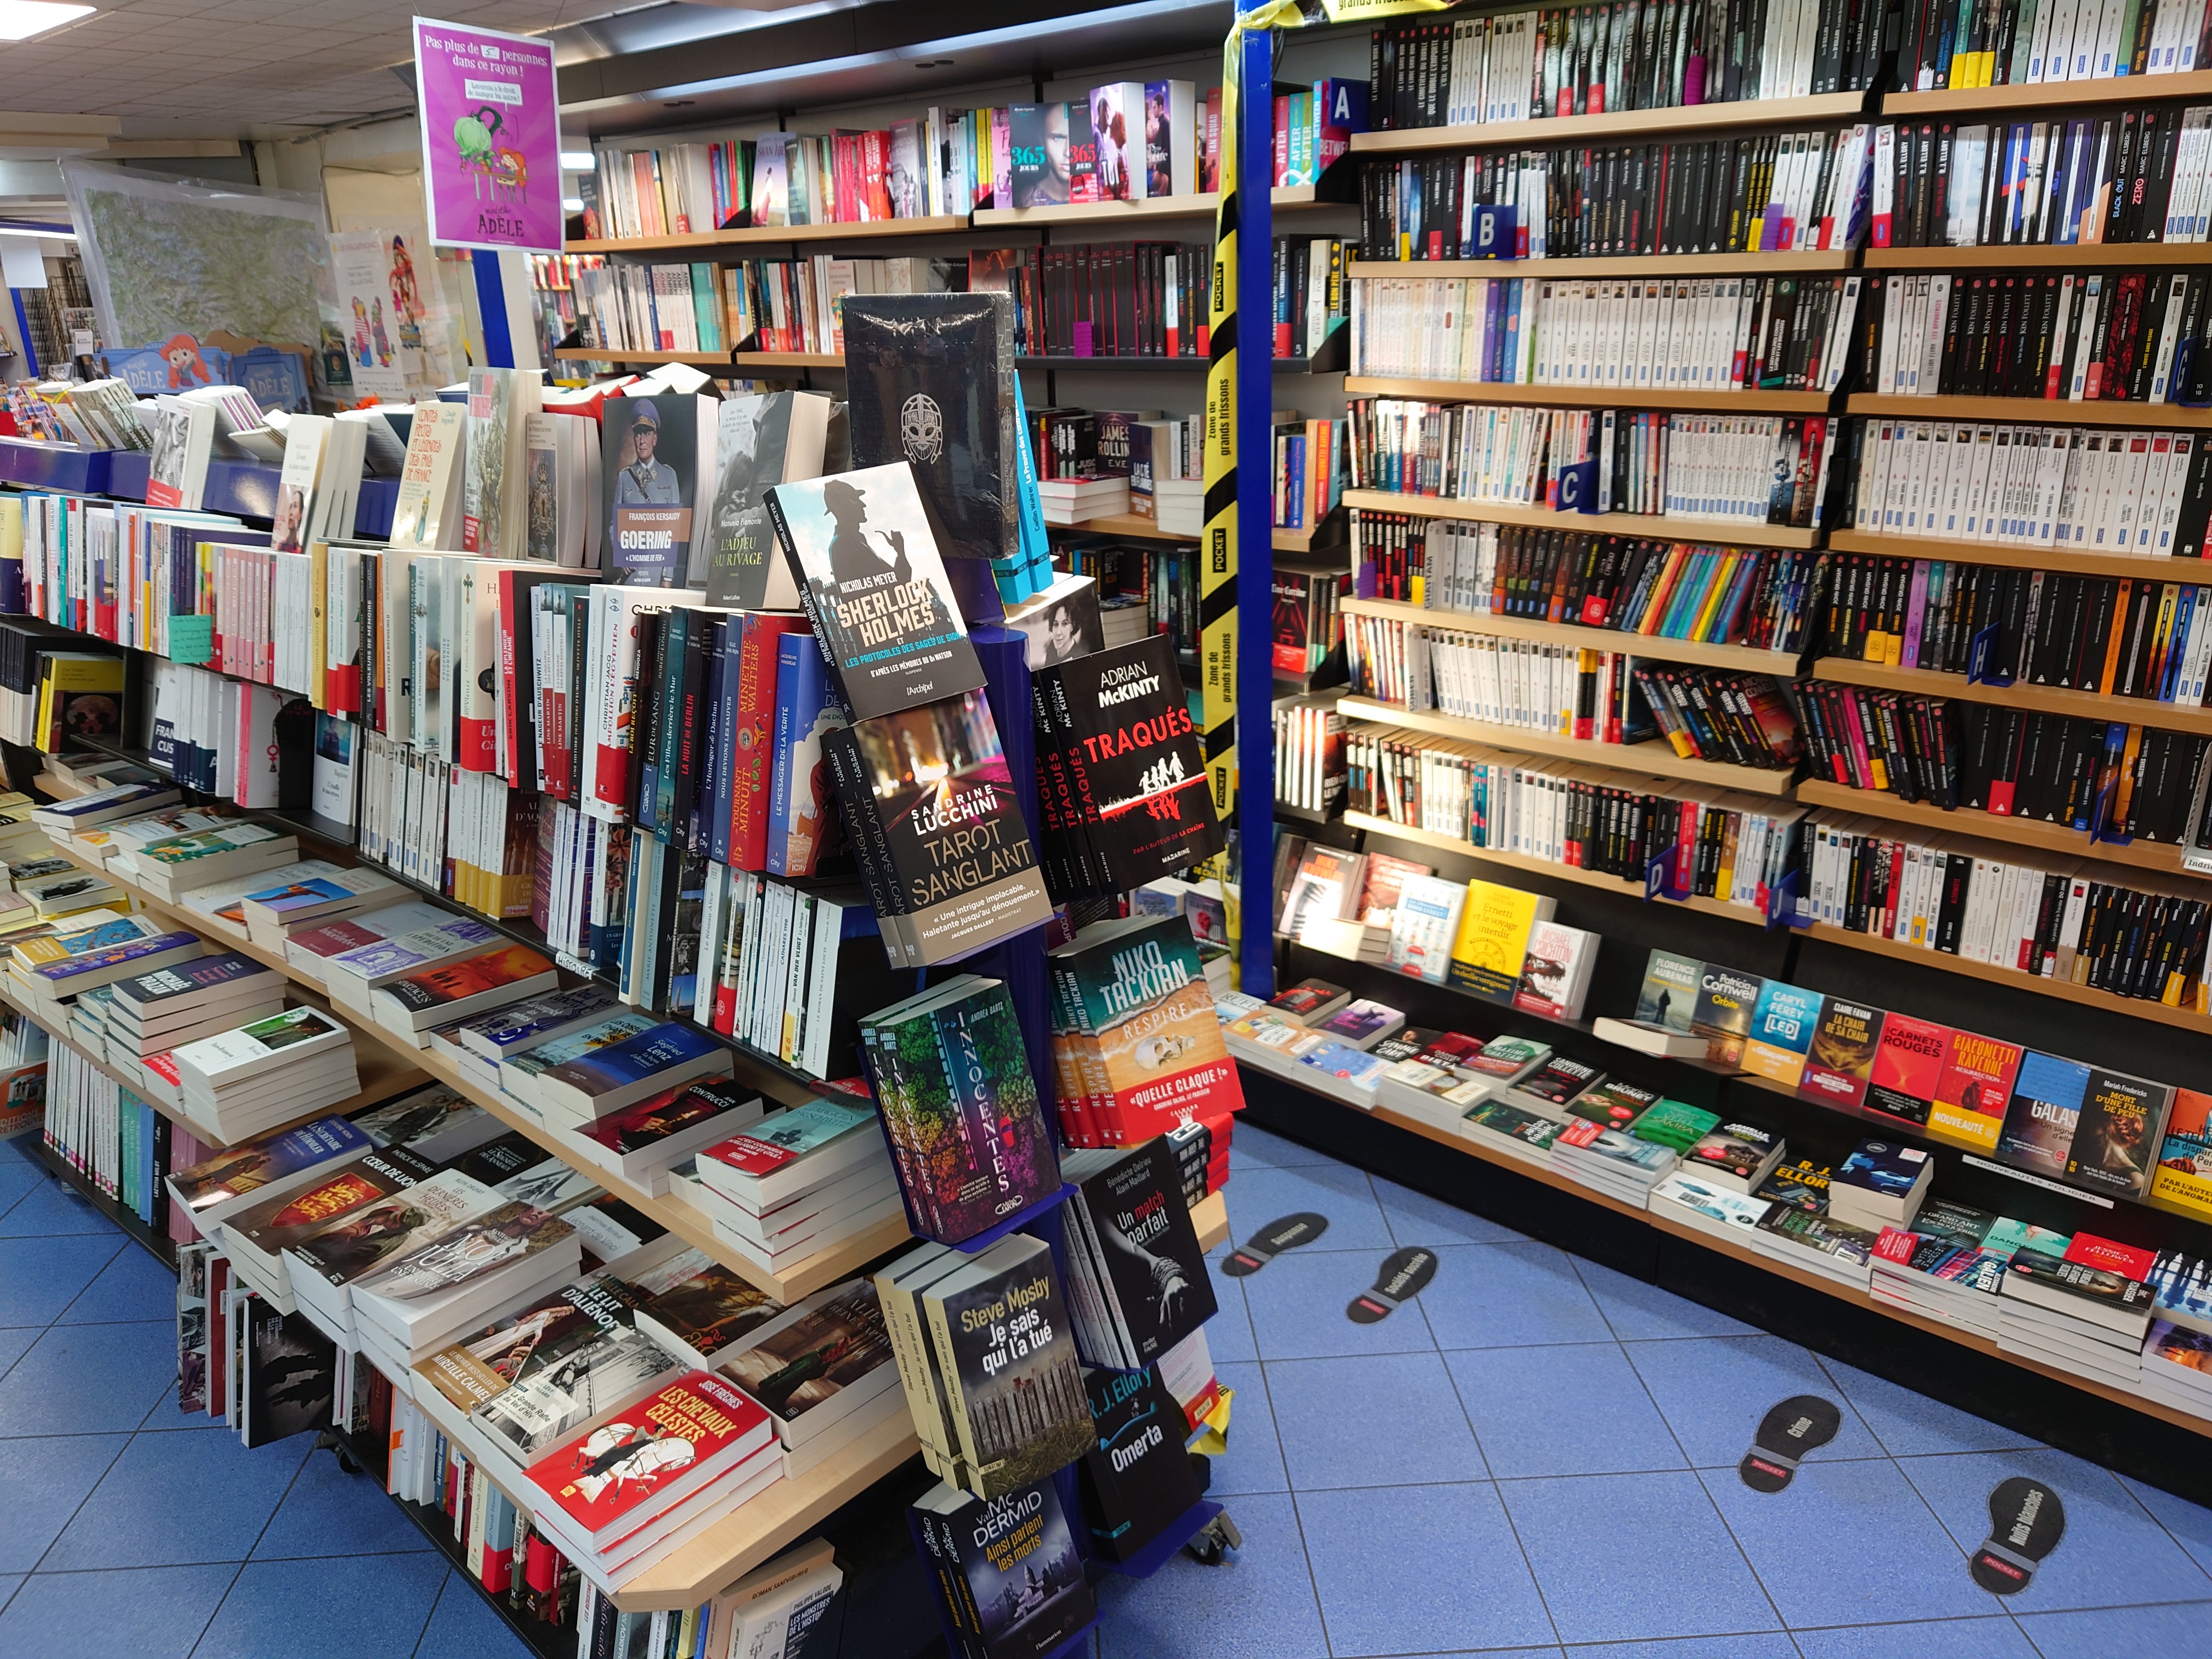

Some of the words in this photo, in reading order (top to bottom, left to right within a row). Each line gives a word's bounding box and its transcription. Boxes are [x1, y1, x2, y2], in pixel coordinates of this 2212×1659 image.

[425, 35, 442, 49] Pas
[445, 39, 465, 53] plus
[467, 42, 478, 54] de
[503, 50, 547, 67] personnes
[453, 54, 475, 70] dans
[477, 61, 488, 71] ce
[490, 63, 518, 76] rayon
[1334, 86, 1350, 119] A
[1012, 146, 1046, 164] 365
[1276, 131, 1286, 162] AFTER
[2123, 131, 2131, 154] ELSBERG
[2132, 178, 2145, 205] ZERO
[2113, 195, 2122, 218] BLACK
[477, 213, 524, 237] ADÈLE
[1480, 213, 1494, 246] B
[1952, 293, 1961, 318] FOLLETT
[1209, 402, 1215, 412] de
[1220, 379, 1228, 423] frissons
[1221, 425, 1230, 456] grands
[1562, 472, 1579, 503] C
[629, 512, 655, 522] FRANÇOIS
[721, 518, 738, 527] Manuela
[741, 517, 761, 526] Piemonte
[620, 530, 672, 549] GOERING
[721, 537, 757, 551] L'ADIEU
[1215, 532, 1224, 569] POCKET
[713, 555, 725, 567] AU
[727, 552, 761, 566] RIVAGE
[839, 579, 872, 594] NICHOLAS
[874, 572, 897, 586] MEYER
[836, 577, 933, 628] SHERLOCK
[859, 603, 935, 647] HOLMES
[845, 657, 859, 668] LES
[860, 646, 901, 665] PROTOCOLES
[902, 642, 914, 652] DES
[916, 636, 936, 650] SAGES
[938, 635, 945, 645] DE
[946, 632, 961, 644] SION
[740, 640, 751, 713] MINETTE
[747, 645, 758, 712] WALTERS
[906, 681, 933, 695] l'Archipel
[1101, 661, 1148, 689] ADRIAN
[1098, 675, 1160, 708] McKINTY
[781, 736, 786, 745] LA
[1083, 706, 1192, 763] TRAQUÉS
[780, 746, 786, 758] DE
[776, 806, 781, 816] LE
[911, 784, 993, 820] SANDRINE
[913, 794, 998, 836] LUCCHINI
[923, 819, 1001, 867] TAROT
[1161, 847, 1190, 864] MAZARINE
[912, 839, 1030, 906] SANGLANT
[1650, 864, 1663, 893] D
[939, 911, 955, 923] Une
[957, 898, 985, 918] intrigue
[985, 884, 1025, 905] implacable.
[923, 922, 959, 939] Haletante
[960, 910, 990, 927] jusqu'au
[1111, 941, 1162, 982] NIKO
[1656, 958, 1695, 975] FLORENCE
[1099, 958, 1189, 1015] TACKIAN
[1654, 967, 1692, 984] AUBENAS
[1702, 974, 1757, 1001] Cornwell
[1720, 974, 1750, 989] Patricia
[970, 1009, 989, 1023] ANDREA
[990, 1002, 1003, 1015] BARTZ
[1712, 995, 1739, 1009] Orbite
[1770, 1002, 1804, 1019] FÉREY
[1773, 992, 1807, 1008] CARYL
[1833, 1003, 1853, 1014] CLAIRE
[1853, 1008, 1871, 1019] FAVAN
[1123, 1002, 1187, 1039] RESPIRE
[1825, 1023, 1835, 1033] DE
[1836, 1025, 1844, 1035] SA
[1846, 1028, 1869, 1043] CHAIR
[1833, 1014, 1842, 1023] LA
[1843, 1017, 1866, 1031] CHAIR
[1883, 1035, 1940, 1058] ROUGES
[1890, 1027, 1943, 1049] CARNETS
[1954, 1035, 2016, 1064] GIACOMETTI
[1957, 1052, 2005, 1077] RAVENNE
[1175, 1070, 1216, 1093] CLAQUE
[2104, 1080, 2120, 1090] Mariah
[2122, 1084, 2147, 1098] Fredericks
[957, 1011, 1009, 1193] INNOCENTES
[2096, 1095, 2120, 1107] D'UNE
[2120, 1101, 2147, 1115] FILLE
[2110, 1092, 2137, 1103] MORT
[1934, 1111, 1984, 1135] NOUVEAUTÉ
[2103, 1105, 2118, 1114] DE
[2119, 1108, 2135, 1119] PEU
[1775, 1167, 1831, 1189] ELLOR
[1798, 1160, 1814, 1173] R.
[1976, 1159, 2044, 1186] NOUVEAUTES
[2048, 1184, 2096, 1203] POLICIER
[419, 1194, 450, 1212] HEURES
[427, 1186, 468, 1209] DERNIÈRES
[1118, 1210, 1134, 1230] Un
[1134, 1190, 1165, 1220] match
[1127, 1206, 1169, 1252] parfait
[1271, 1222, 1308, 1246] Suspense
[1384, 1272, 1412, 1295] Société
[1403, 1252, 1429, 1276] secrète
[961, 1300, 1005, 1333] Steve
[1007, 1276, 1050, 1314] Mosby
[988, 1323, 1007, 1347] Je
[1010, 1307, 1040, 1336] sais
[982, 1345, 1008, 1376] qui
[1011, 1336, 1028, 1360] l'a
[1029, 1319, 1053, 1349] tué
[432, 1353, 463, 1380] MIREILLE
[460, 1376, 492, 1401] CALMEL
[1103, 1389, 1114, 1410] J.
[1113, 1369, 1151, 1403] Ellory
[698, 1380, 720, 1393] JOSÉ
[713, 1387, 743, 1409] FRÈCHES
[517, 1395, 537, 1410] Grande
[535, 1409, 551, 1422] Rafle
[518, 1405, 534, 1419] d'Hiv
[658, 1386, 689, 1404] LES
[678, 1396, 737, 1439] CHEVAUX
[646, 1403, 706, 1442] CÉLESTES
[1787, 1417, 1813, 1438] Crime
[1111, 1424, 1164, 1473] Omerta
[1753, 1460, 1784, 1475] POCKET
[973, 1491, 1042, 1548] DERMID
[977, 1509, 990, 1525] Val
[987, 1493, 1014, 1516] Mc
[2016, 1488, 2044, 1530] blanches
[986, 1537, 1010, 1562] Ainsi
[1011, 1514, 1043, 1547] parlent
[2008, 1521, 2031, 1547] Nuits
[996, 1554, 1014, 1572] les
[1013, 1535, 1041, 1562] morts
[1985, 1558, 2020, 1578] POCKET
[1035, 1629, 1062, 1650] Flammarion
